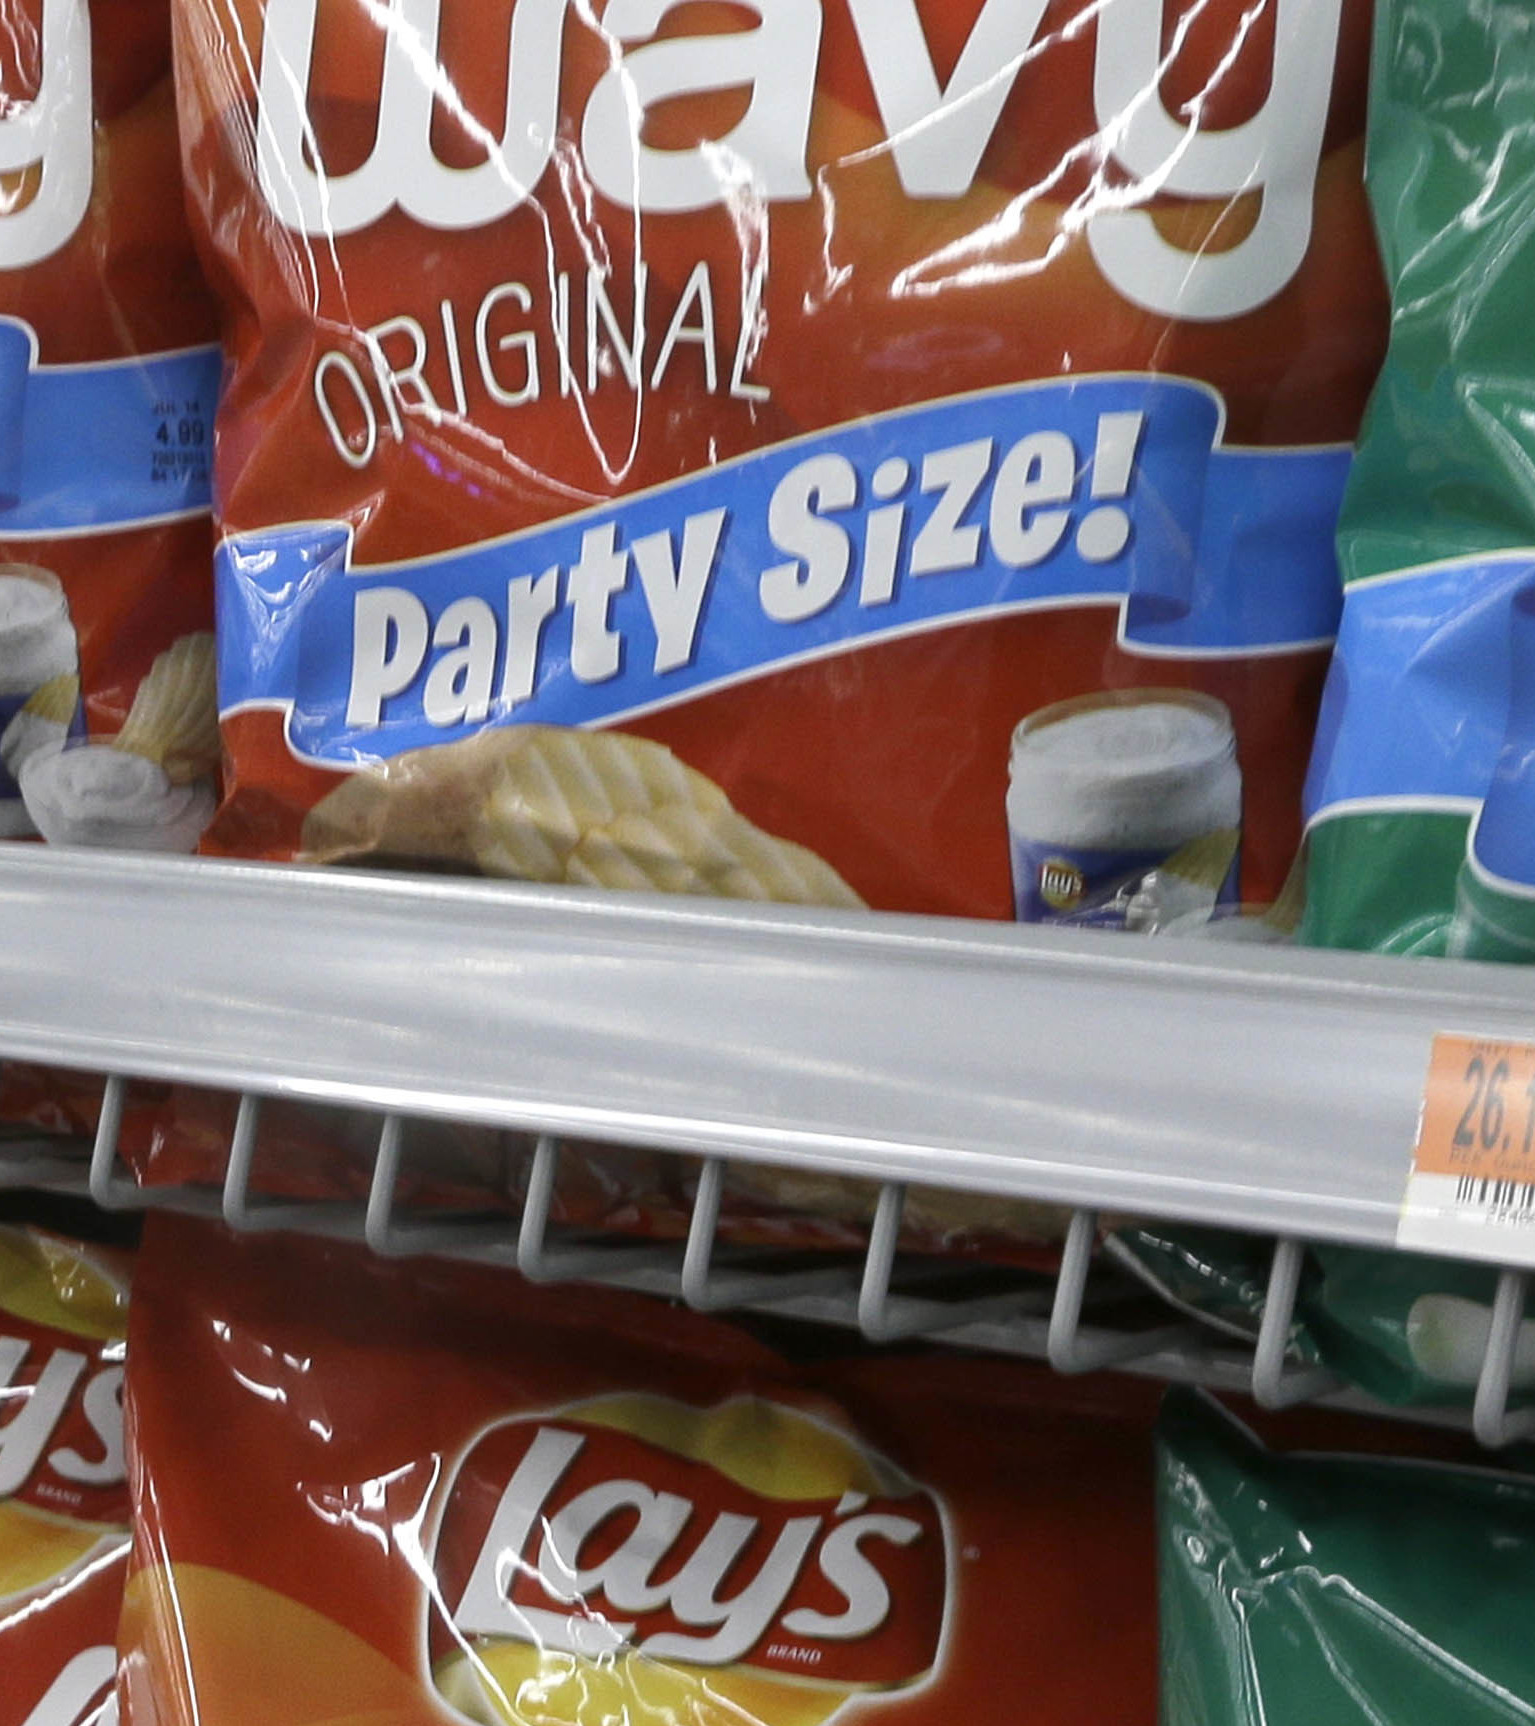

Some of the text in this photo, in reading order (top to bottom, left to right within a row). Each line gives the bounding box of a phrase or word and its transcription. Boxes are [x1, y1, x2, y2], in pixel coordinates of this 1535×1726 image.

[255, 0, 1338, 322] wavy
[311, 260, 771, 469] ORIGINAL
[344, 410, 1144, 730] Party Size!
[457, 1424, 922, 1663] Lay's
[766, 1641, 823, 1666] BRAND
